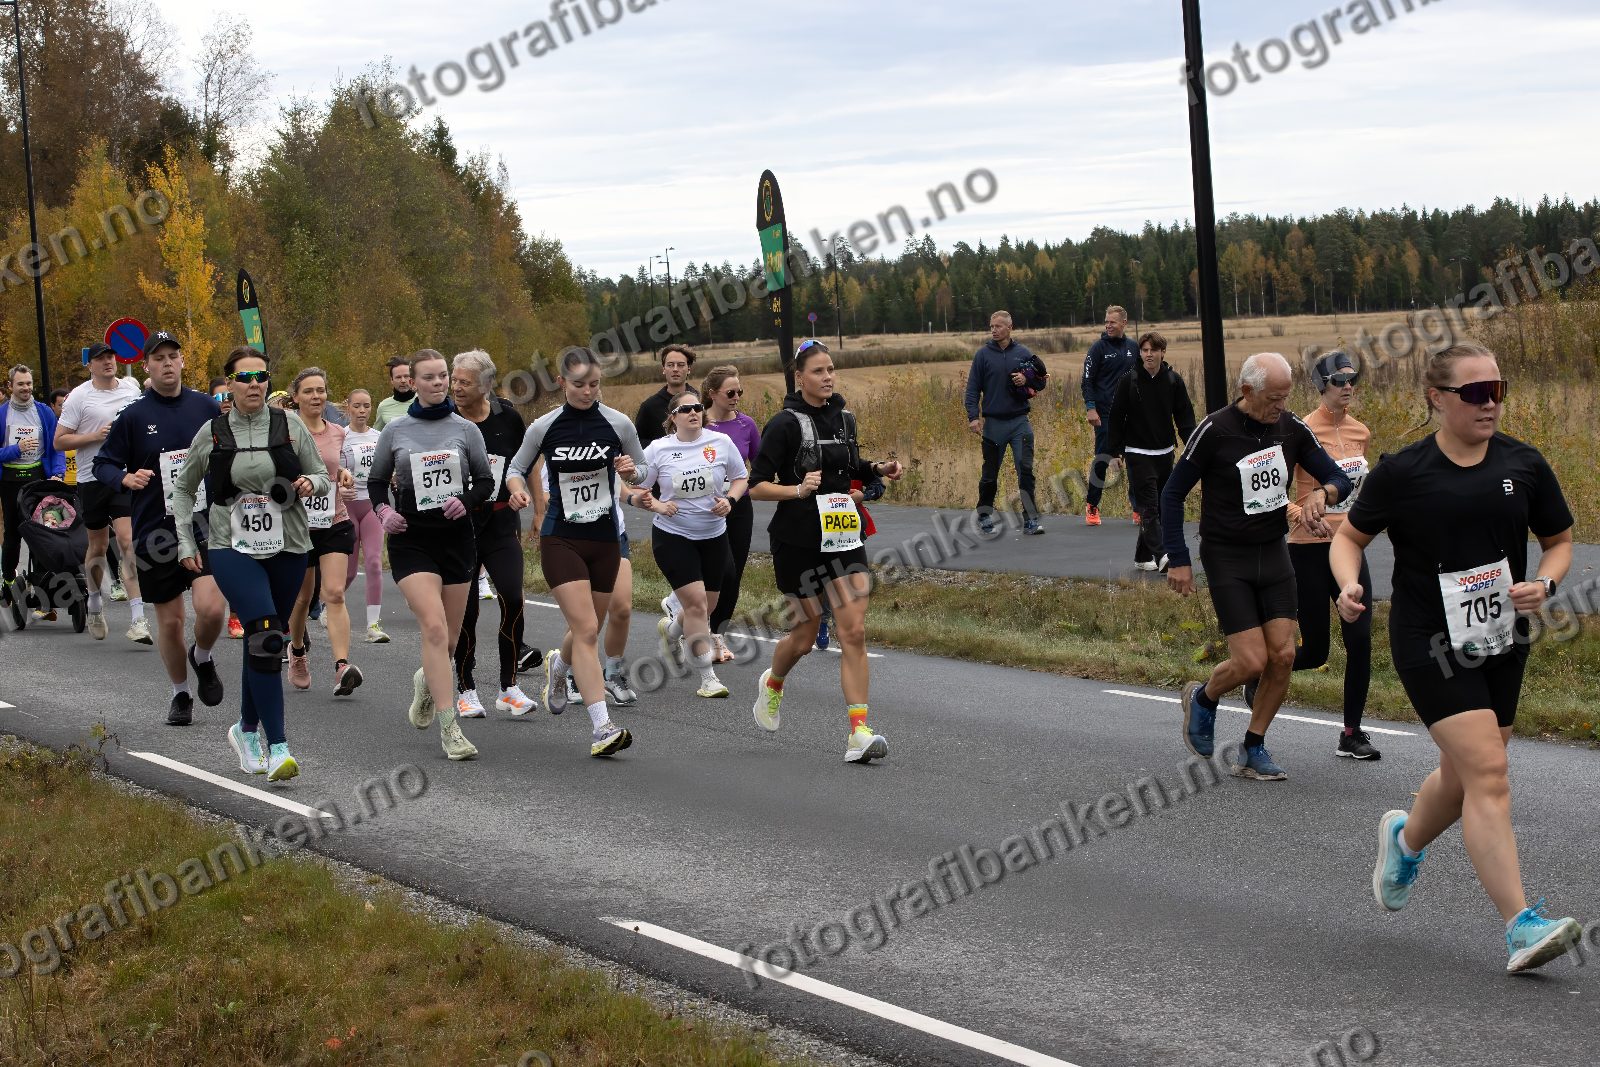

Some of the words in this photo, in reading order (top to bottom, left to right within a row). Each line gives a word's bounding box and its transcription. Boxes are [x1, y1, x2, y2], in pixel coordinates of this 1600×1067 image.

[421, 453, 451, 462] NORGES
[1247, 451, 1276, 465] NORGES
[422, 468, 452, 489] 573
[681, 476, 706, 492] 479
[1251, 468, 1281, 492] 898
[240, 496, 271, 504] NORGES
[570, 483, 600, 504] 707
[305, 496, 329, 511] 480
[241, 513, 273, 533] 450
[825, 514, 857, 530] PACE
[253, 539, 282, 548] Aurskog
[1458, 569, 1502, 586] NORGES
[1463, 579, 1497, 593] LØPET
[1460, 592, 1502, 628] 705
